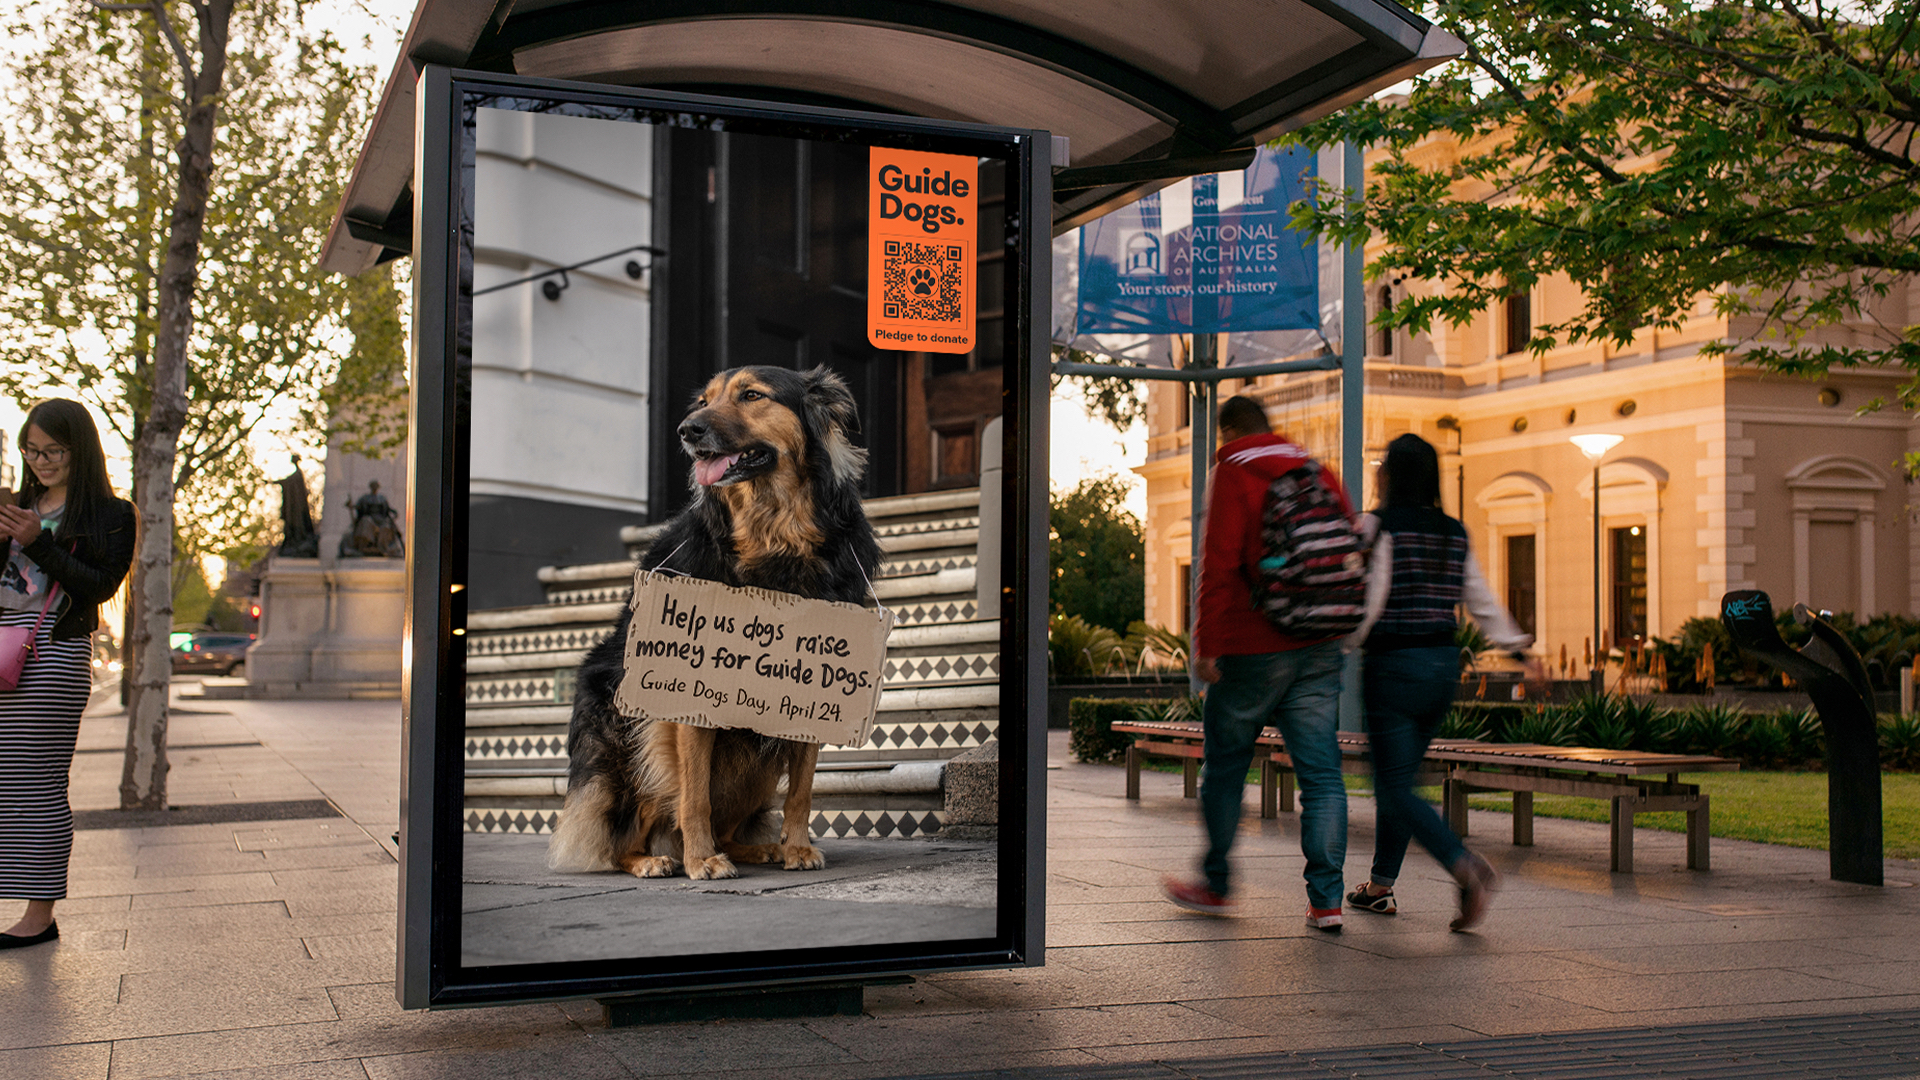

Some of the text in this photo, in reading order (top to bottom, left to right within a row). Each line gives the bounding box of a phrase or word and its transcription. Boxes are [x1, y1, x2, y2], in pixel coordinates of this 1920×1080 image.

[878, 164, 970, 198] Guide
[879, 193, 965, 234] Dogs.
[1173, 223, 1279, 243] NATIONAL
[1173, 243, 1278, 264] ARCHIVES
[1173, 265, 1278, 276] OF AUSTRALIA
[1117, 280, 1278, 298] Your story, our history
[875, 329, 968, 344] Pledge to donate
[660, 593, 851, 658] Help us dogs raise
[635, 639, 873, 696] money for Guide Dogs.
[640, 669, 843, 723] Guide Dogs Day, April 24.
